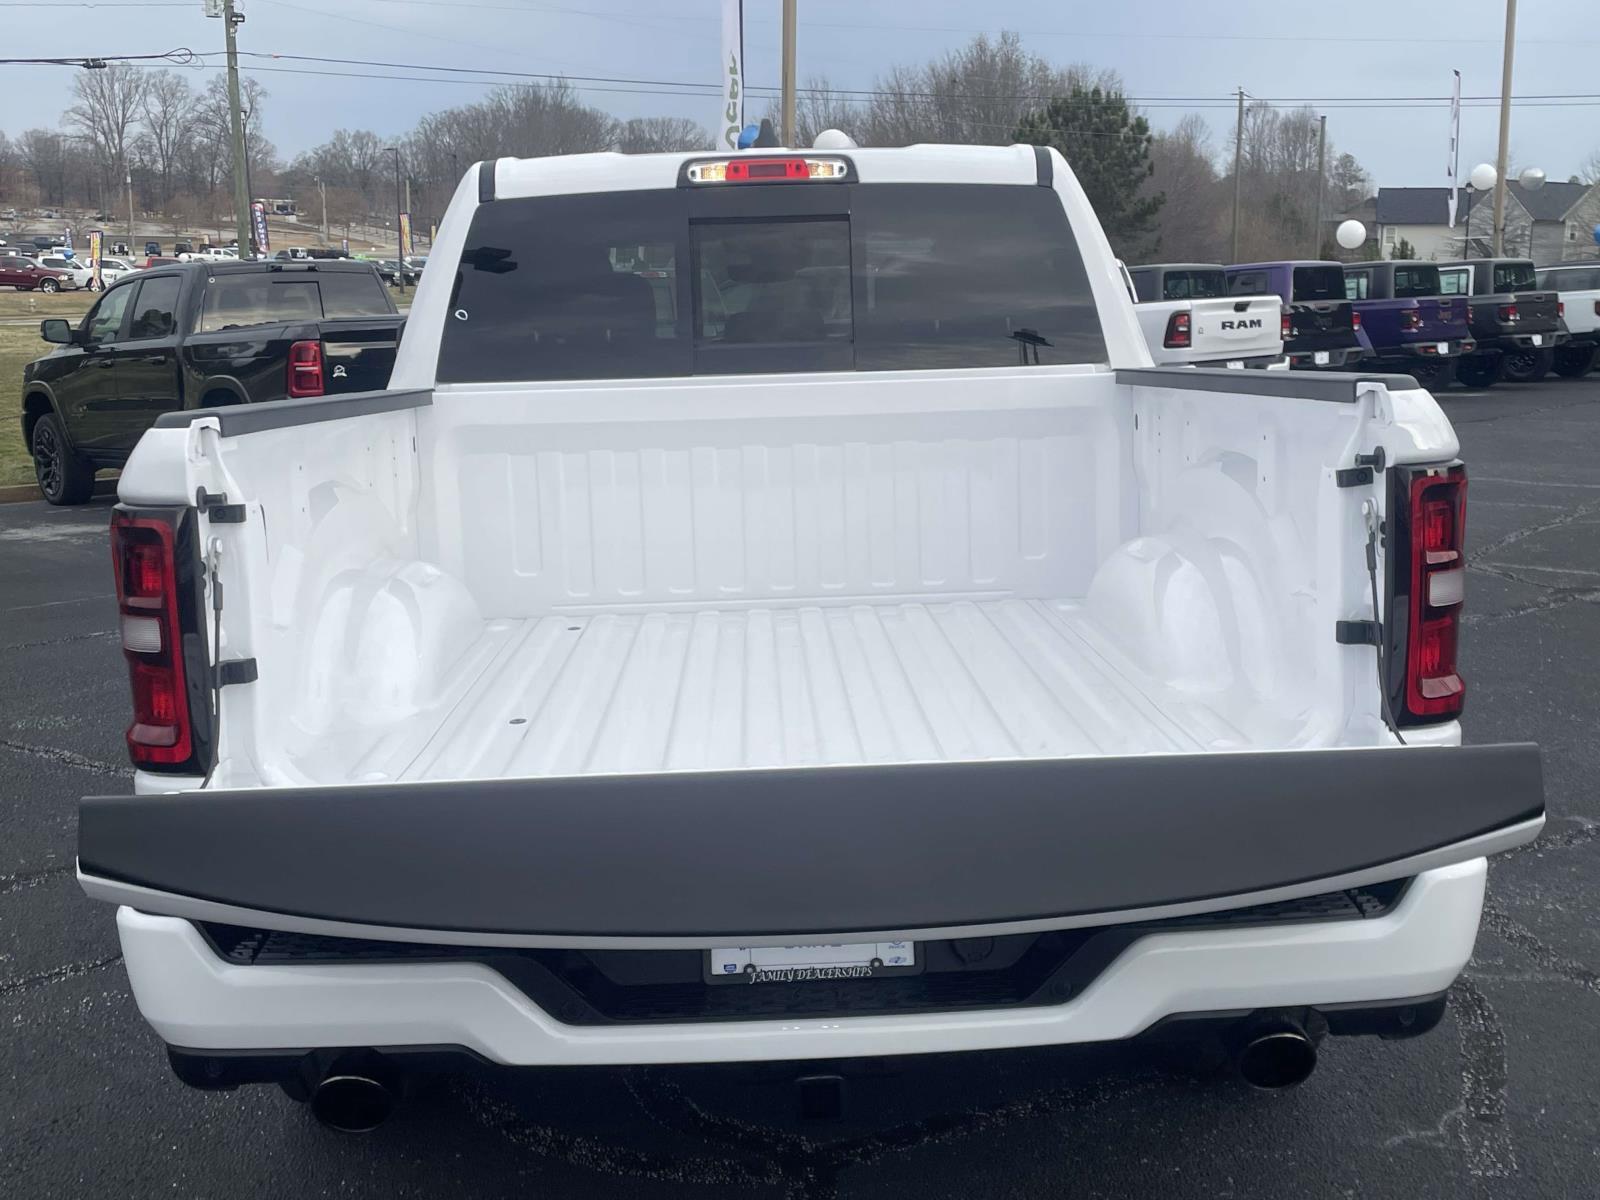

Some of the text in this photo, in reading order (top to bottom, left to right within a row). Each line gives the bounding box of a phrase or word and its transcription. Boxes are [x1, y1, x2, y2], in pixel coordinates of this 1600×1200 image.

[1221, 319, 1262, 330] RAM
[749, 968, 794, 984] FAMILY
[797, 966, 873, 980] DEALERSHIPS
